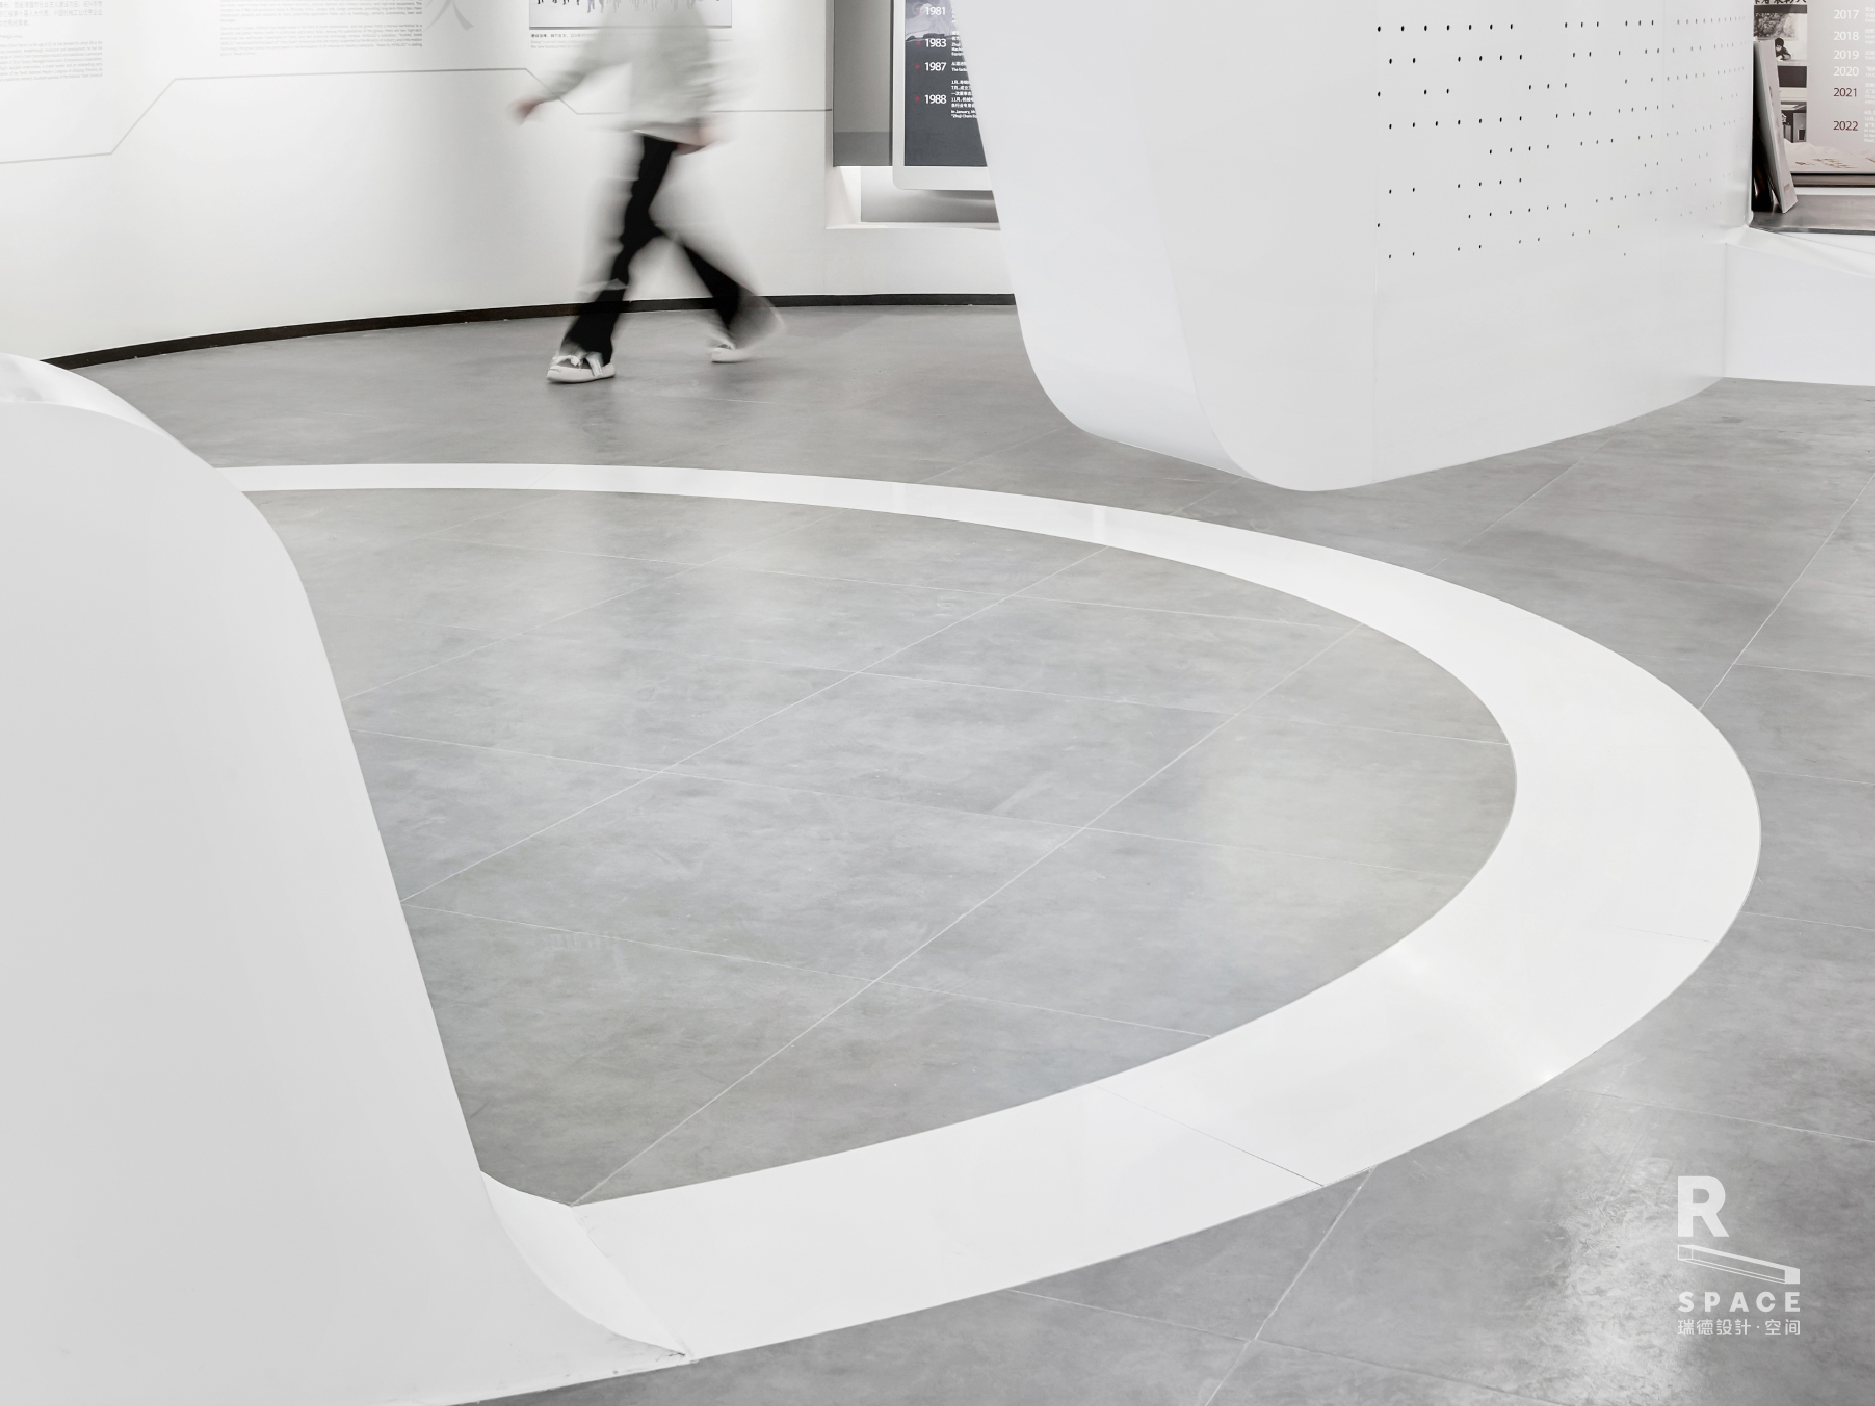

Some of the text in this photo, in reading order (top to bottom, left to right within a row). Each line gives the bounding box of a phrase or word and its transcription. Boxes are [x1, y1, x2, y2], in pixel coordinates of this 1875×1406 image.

[925, 6, 946, 16] 1981
[1834, 9, 1860, 19] 2017
[1834, 31, 1860, 41] 2018
[924, 38, 947, 48] 1983
[1834, 50, 1860, 60] 2019
[924, 62, 947, 72] 1987
[1834, 66, 1859, 76] 2020
[1834, 87, 1857, 97] 2021
[924, 94, 947, 105] 1988
[1833, 120, 1859, 131] 2022
